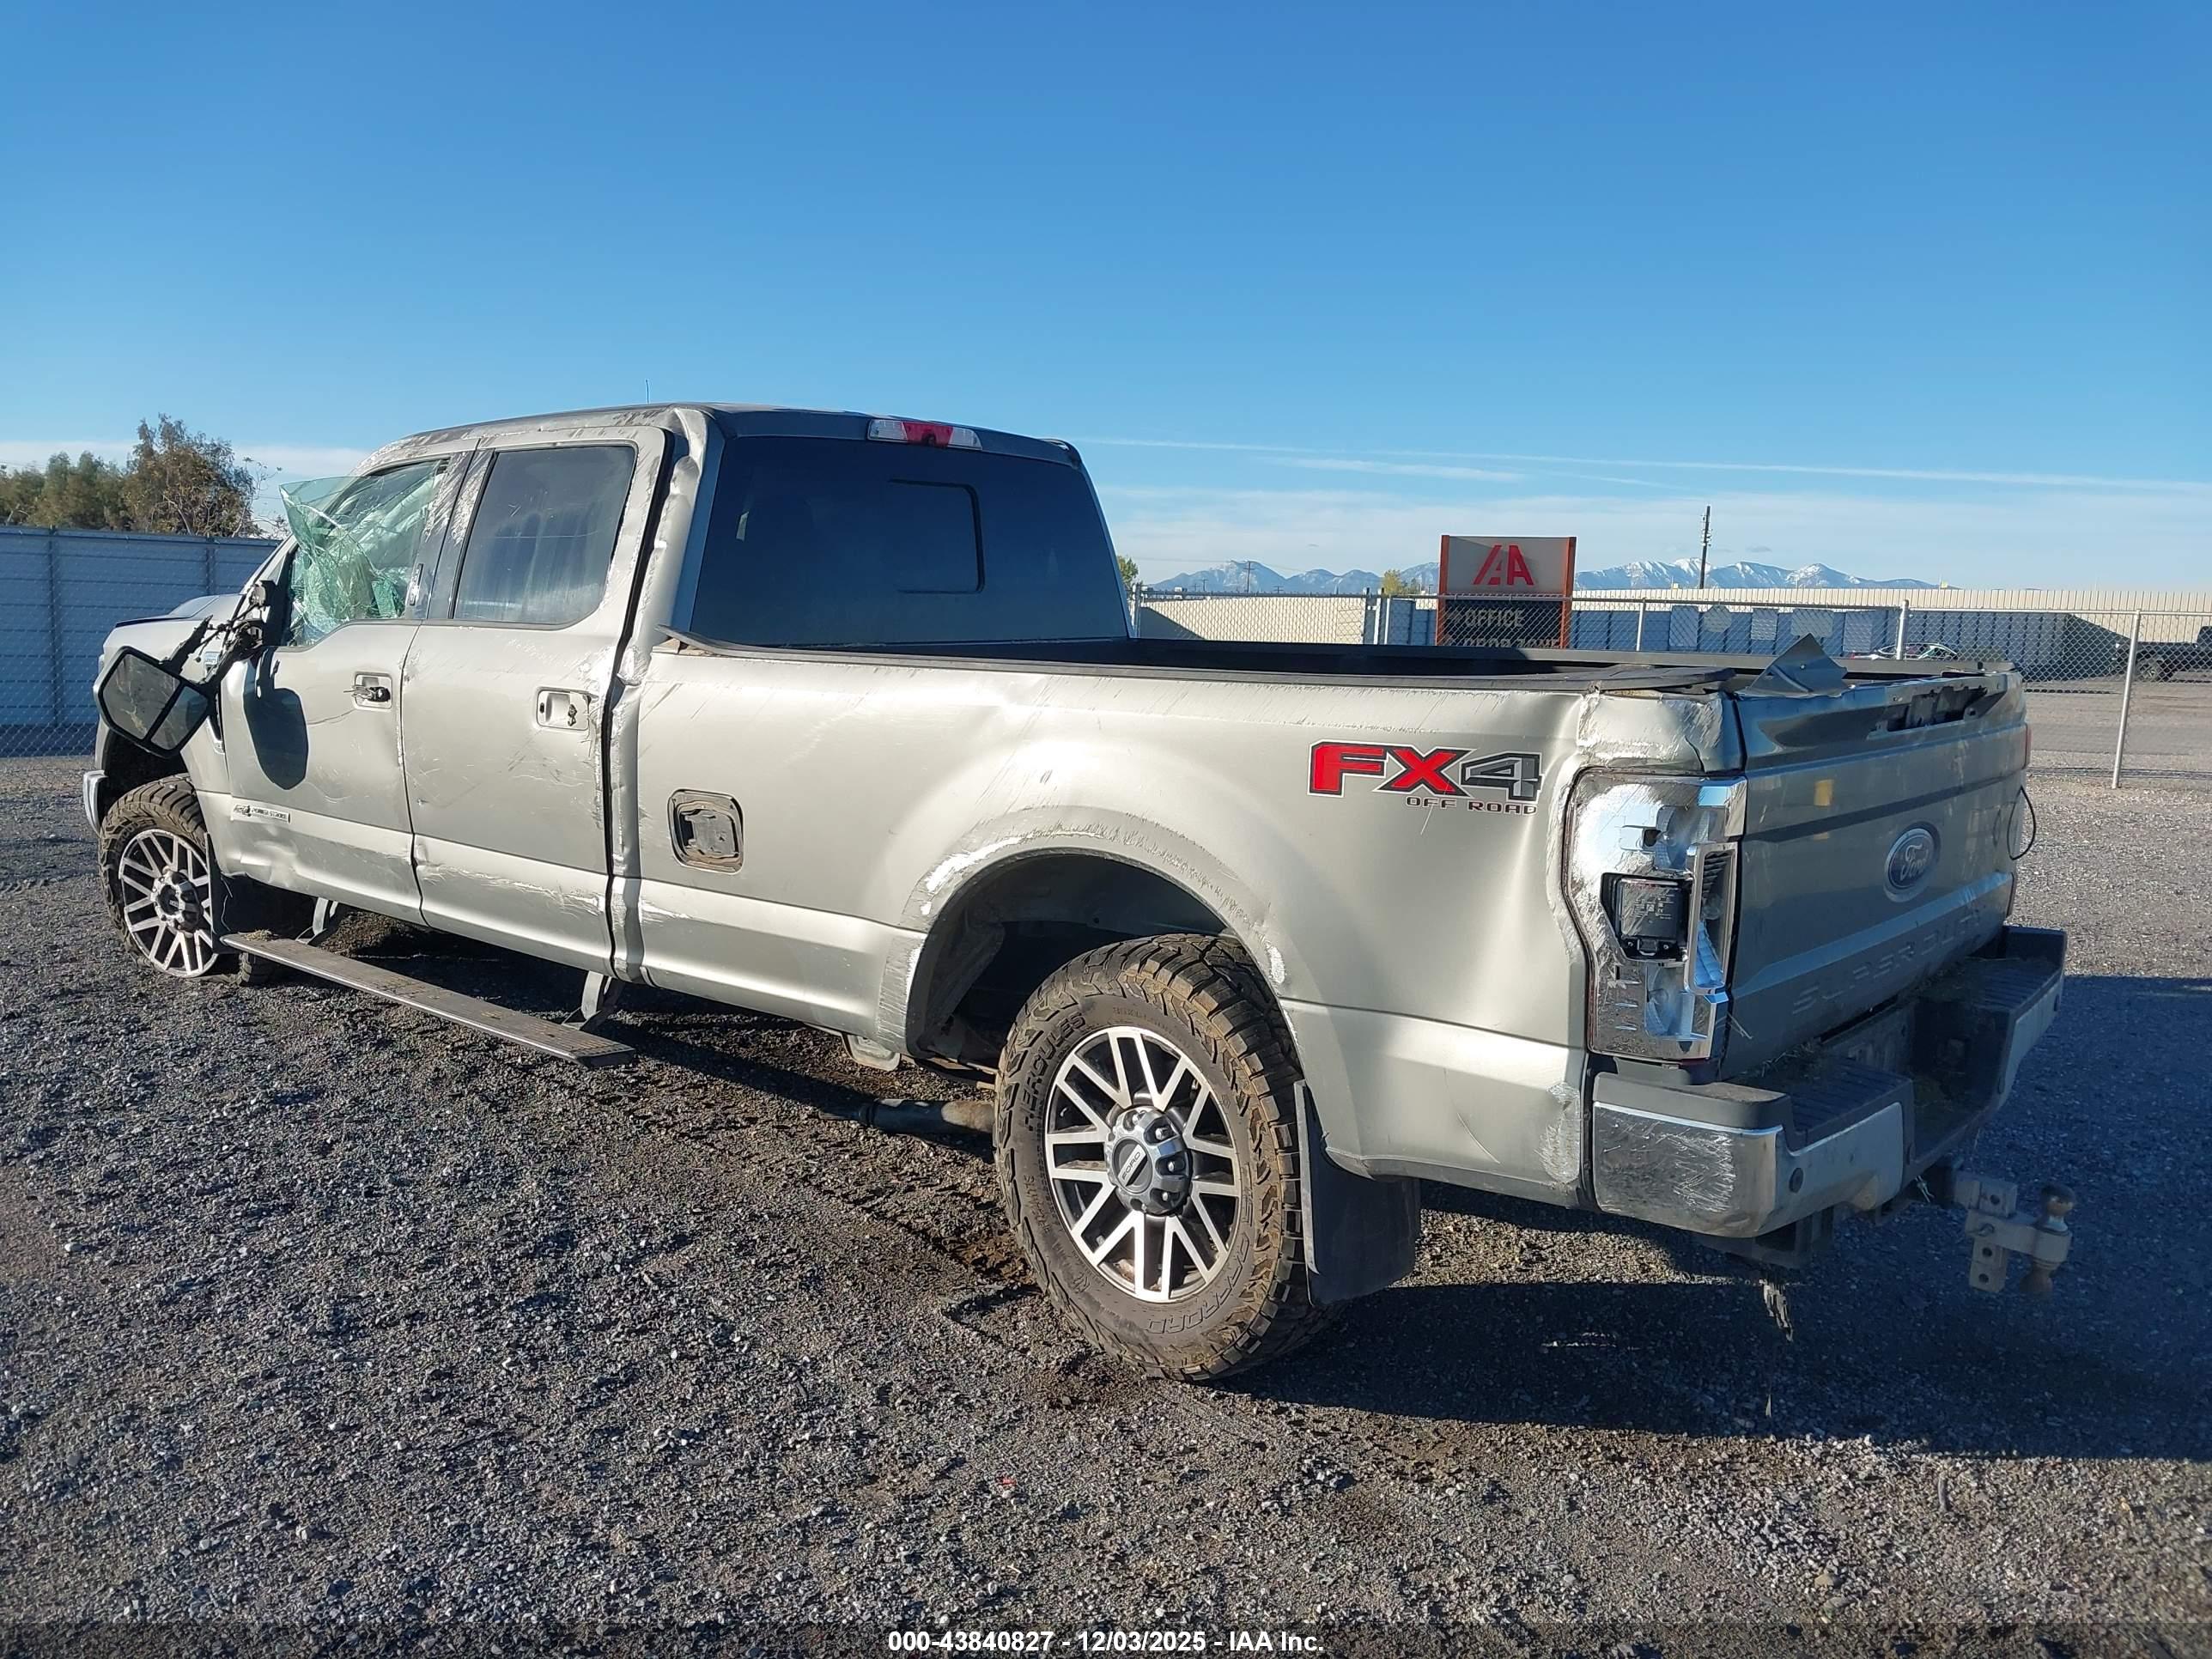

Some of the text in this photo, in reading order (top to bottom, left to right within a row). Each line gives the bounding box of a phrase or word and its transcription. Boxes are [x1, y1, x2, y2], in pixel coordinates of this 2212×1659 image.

[1465, 610, 1524, 627] OFFICE
[1307, 738, 1543, 804] FX4
[1406, 796, 1538, 815] OFF ROAD
[1900, 844, 1929, 881] Ford
[1022, 1011, 1086, 1132] HERCULES
[1121, 1151, 1141, 1181] FORD
